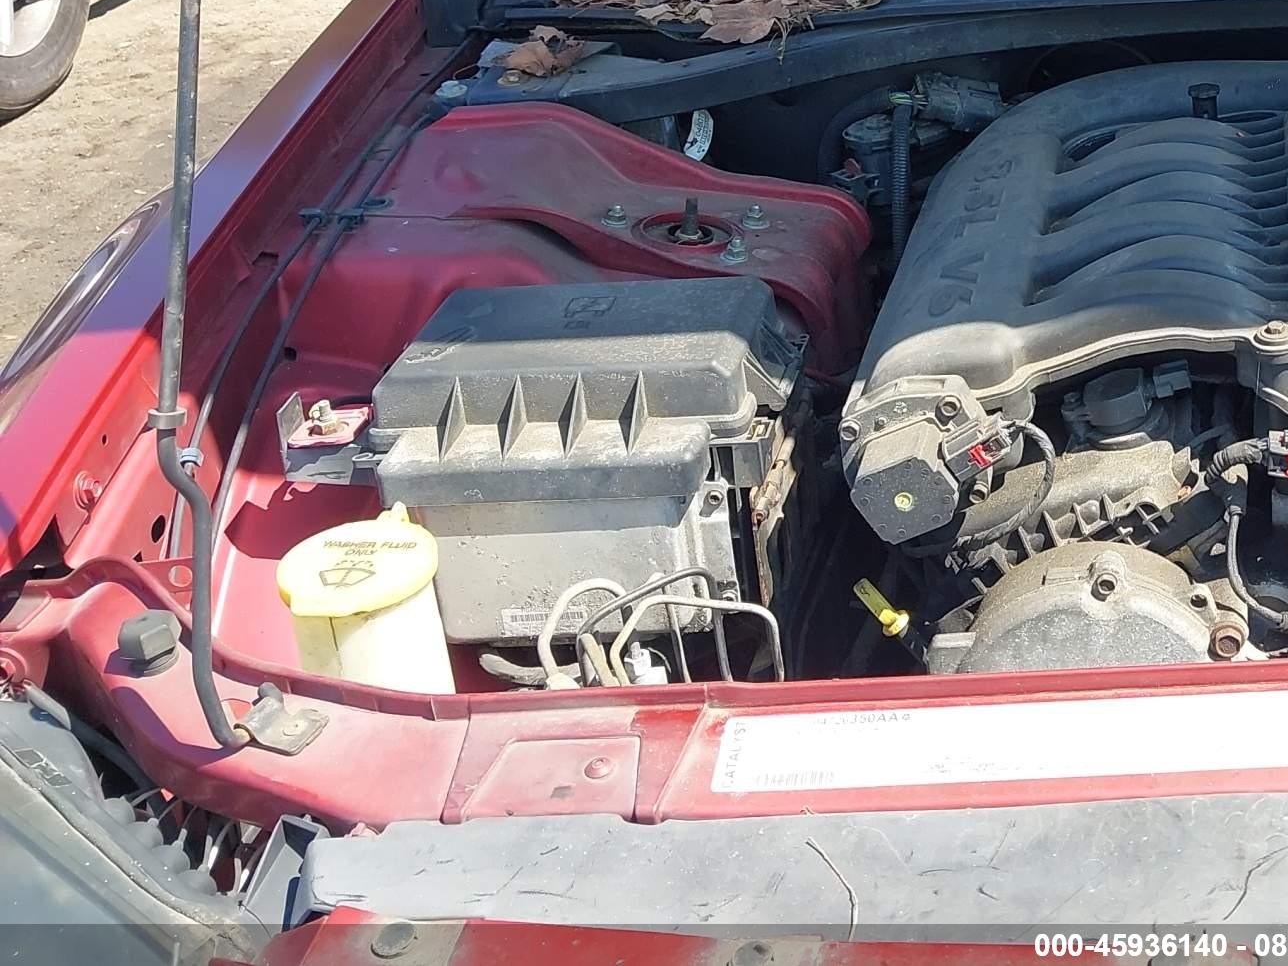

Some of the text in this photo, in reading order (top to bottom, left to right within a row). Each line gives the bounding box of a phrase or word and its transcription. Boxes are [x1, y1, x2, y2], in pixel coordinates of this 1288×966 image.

[927, 251, 989, 319] V6
[322, 540, 418, 550] WASHER FLUID
[344, 548, 378, 557] ONLY
